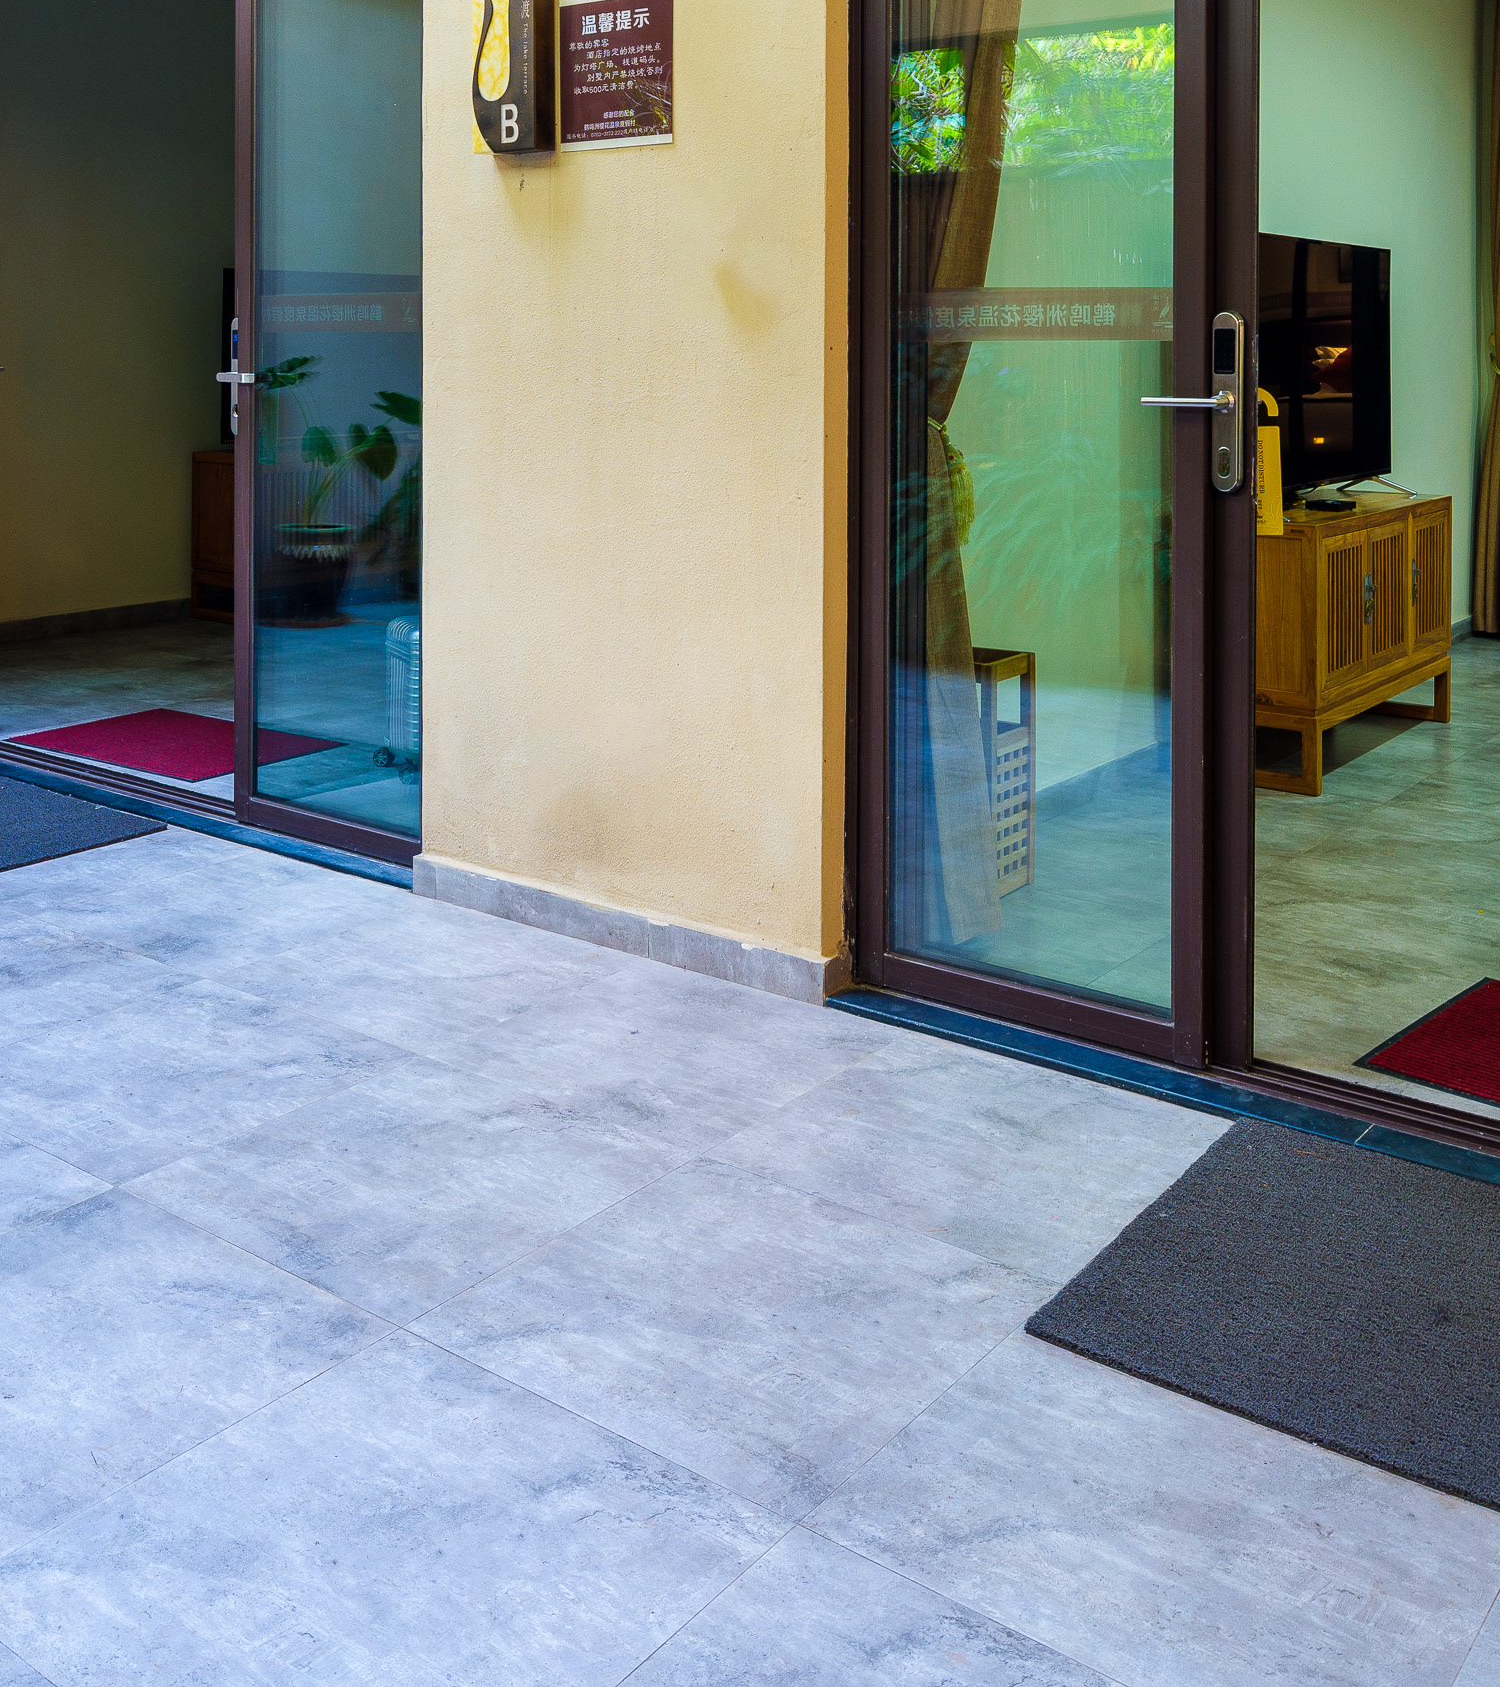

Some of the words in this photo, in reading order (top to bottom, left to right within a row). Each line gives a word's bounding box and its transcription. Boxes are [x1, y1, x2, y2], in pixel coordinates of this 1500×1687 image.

[581, 7, 650, 36] 温馨提示
[501, 103, 519, 144] B
